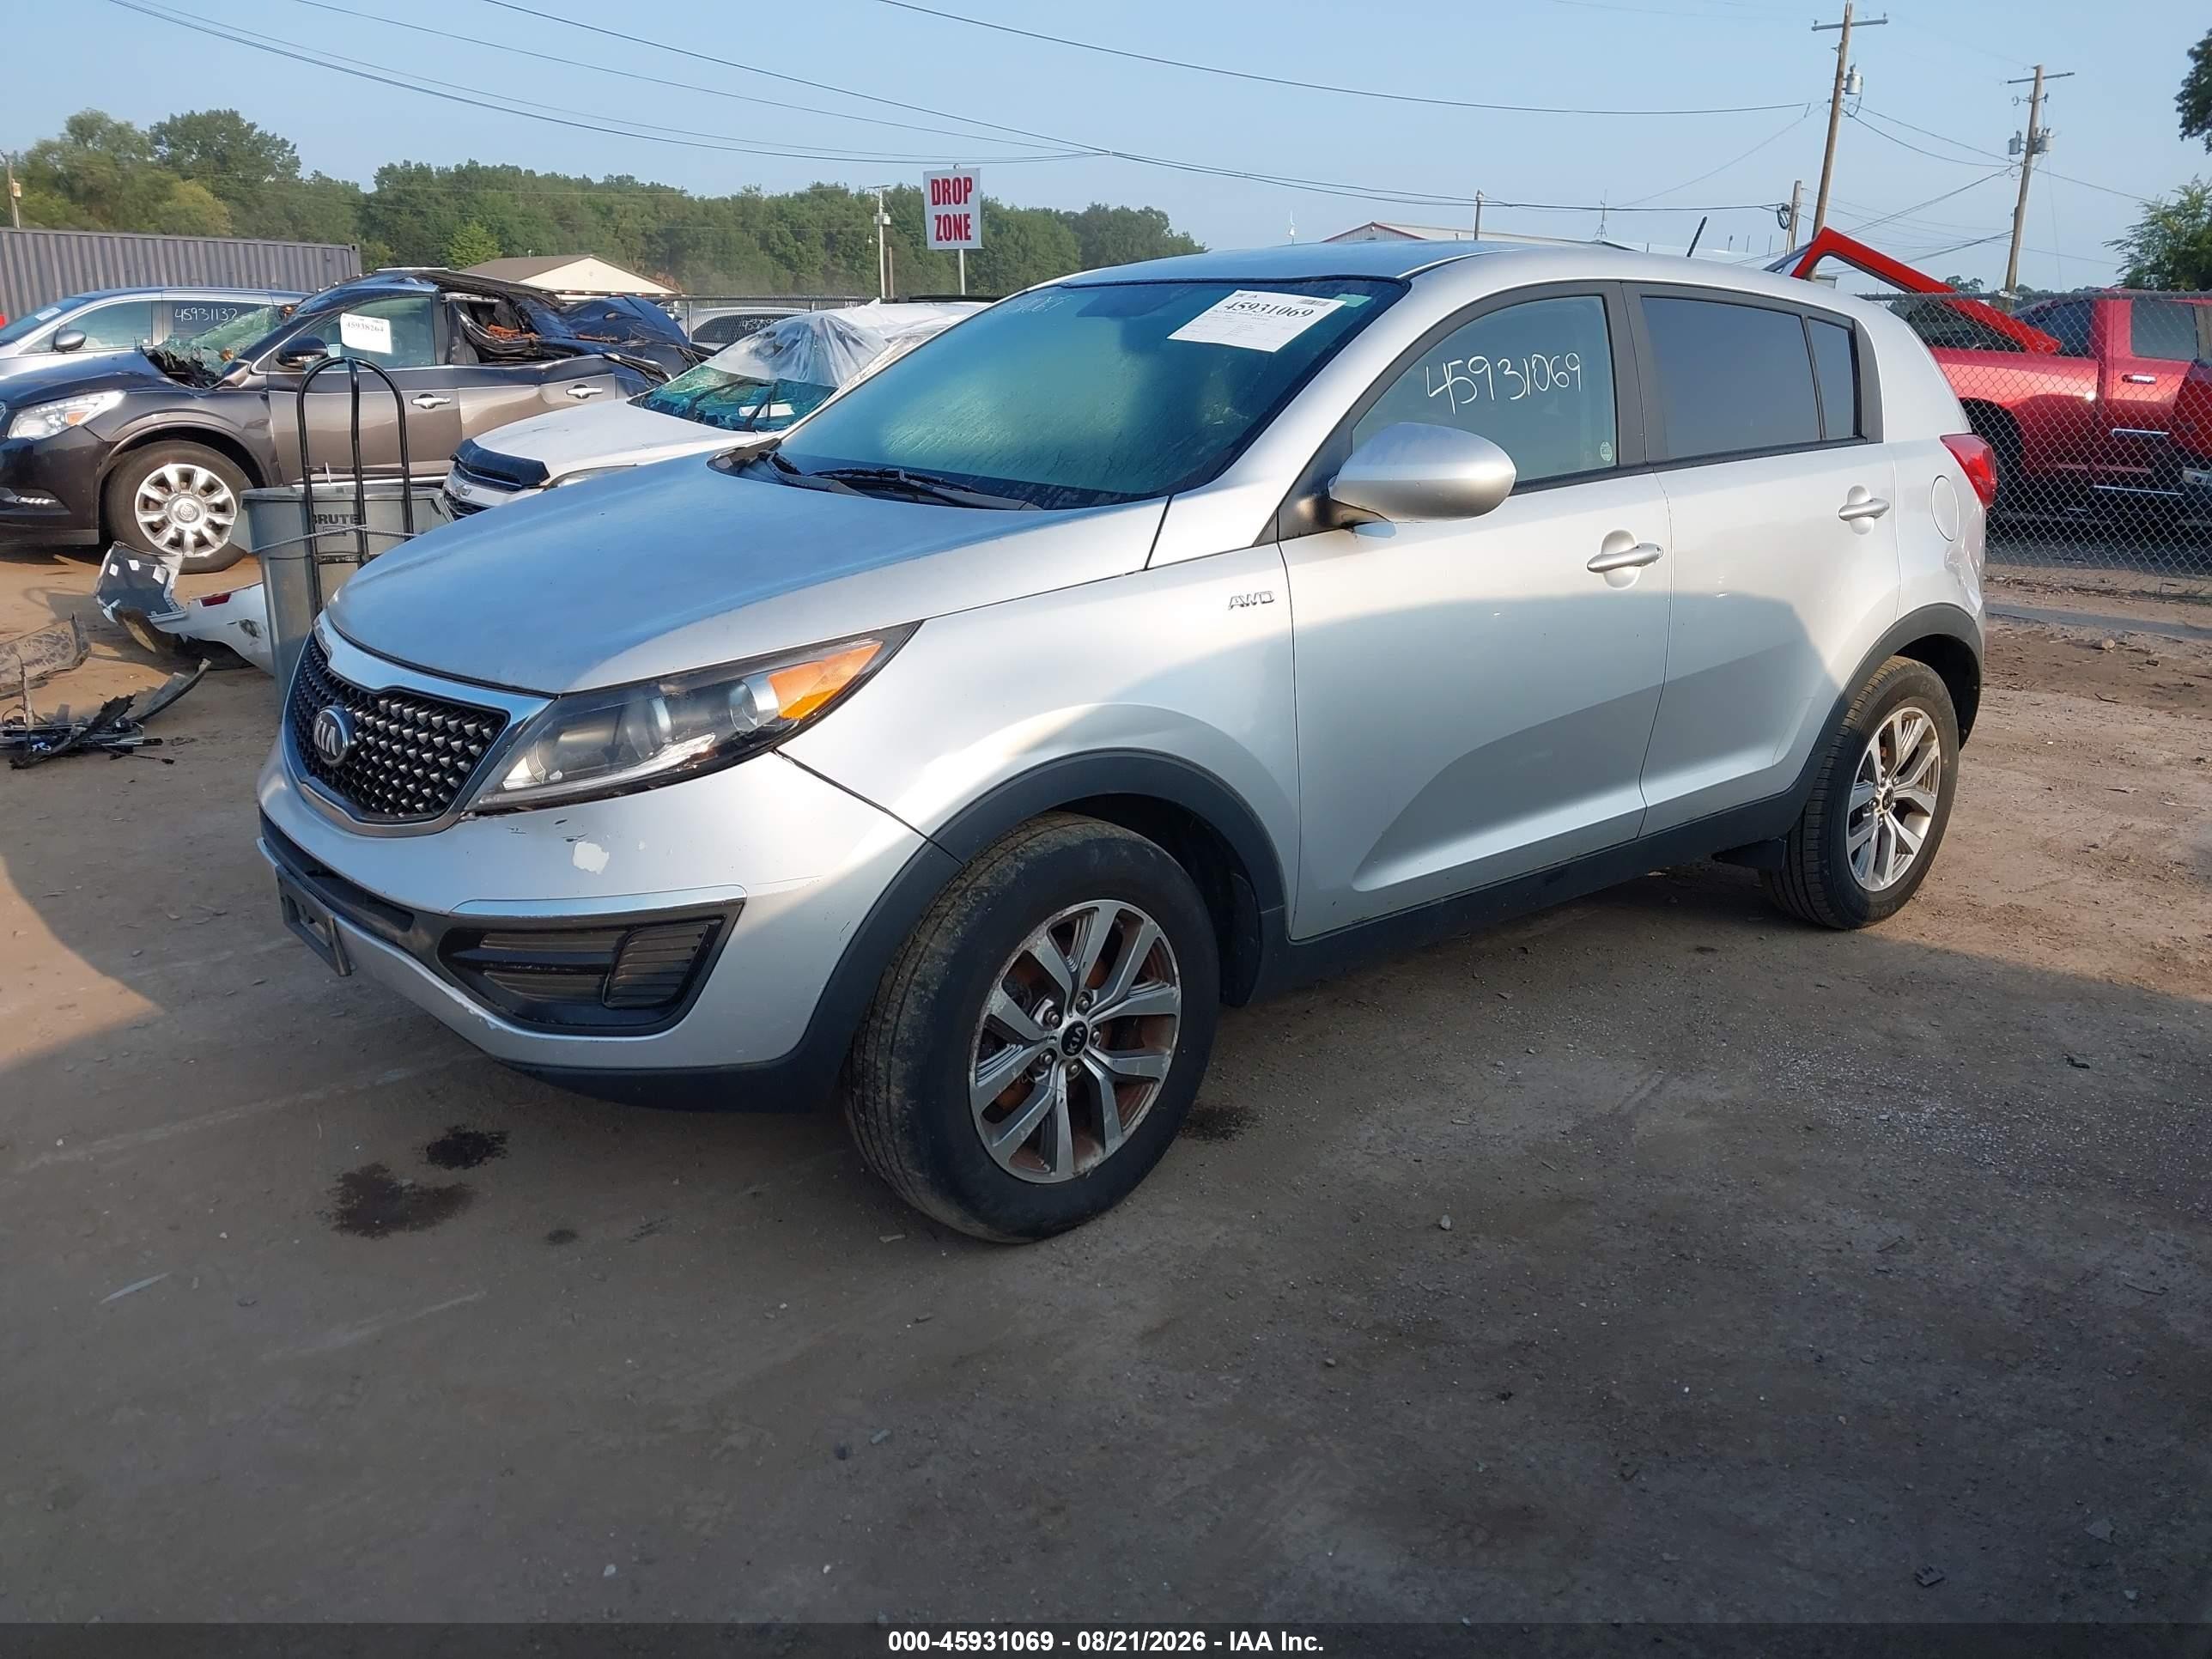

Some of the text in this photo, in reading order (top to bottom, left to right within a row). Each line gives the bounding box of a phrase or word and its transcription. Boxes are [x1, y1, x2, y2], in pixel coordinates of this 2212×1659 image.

[930, 176, 973, 206] DROP
[934, 213, 971, 241] ZONE
[1224, 301, 1315, 319] 45931069
[1425, 352, 1582, 416] 45931069
[1228, 591, 1274, 611] AWD
[313, 714, 337, 757] KIA
[1066, 1026, 1085, 1054] KIA
